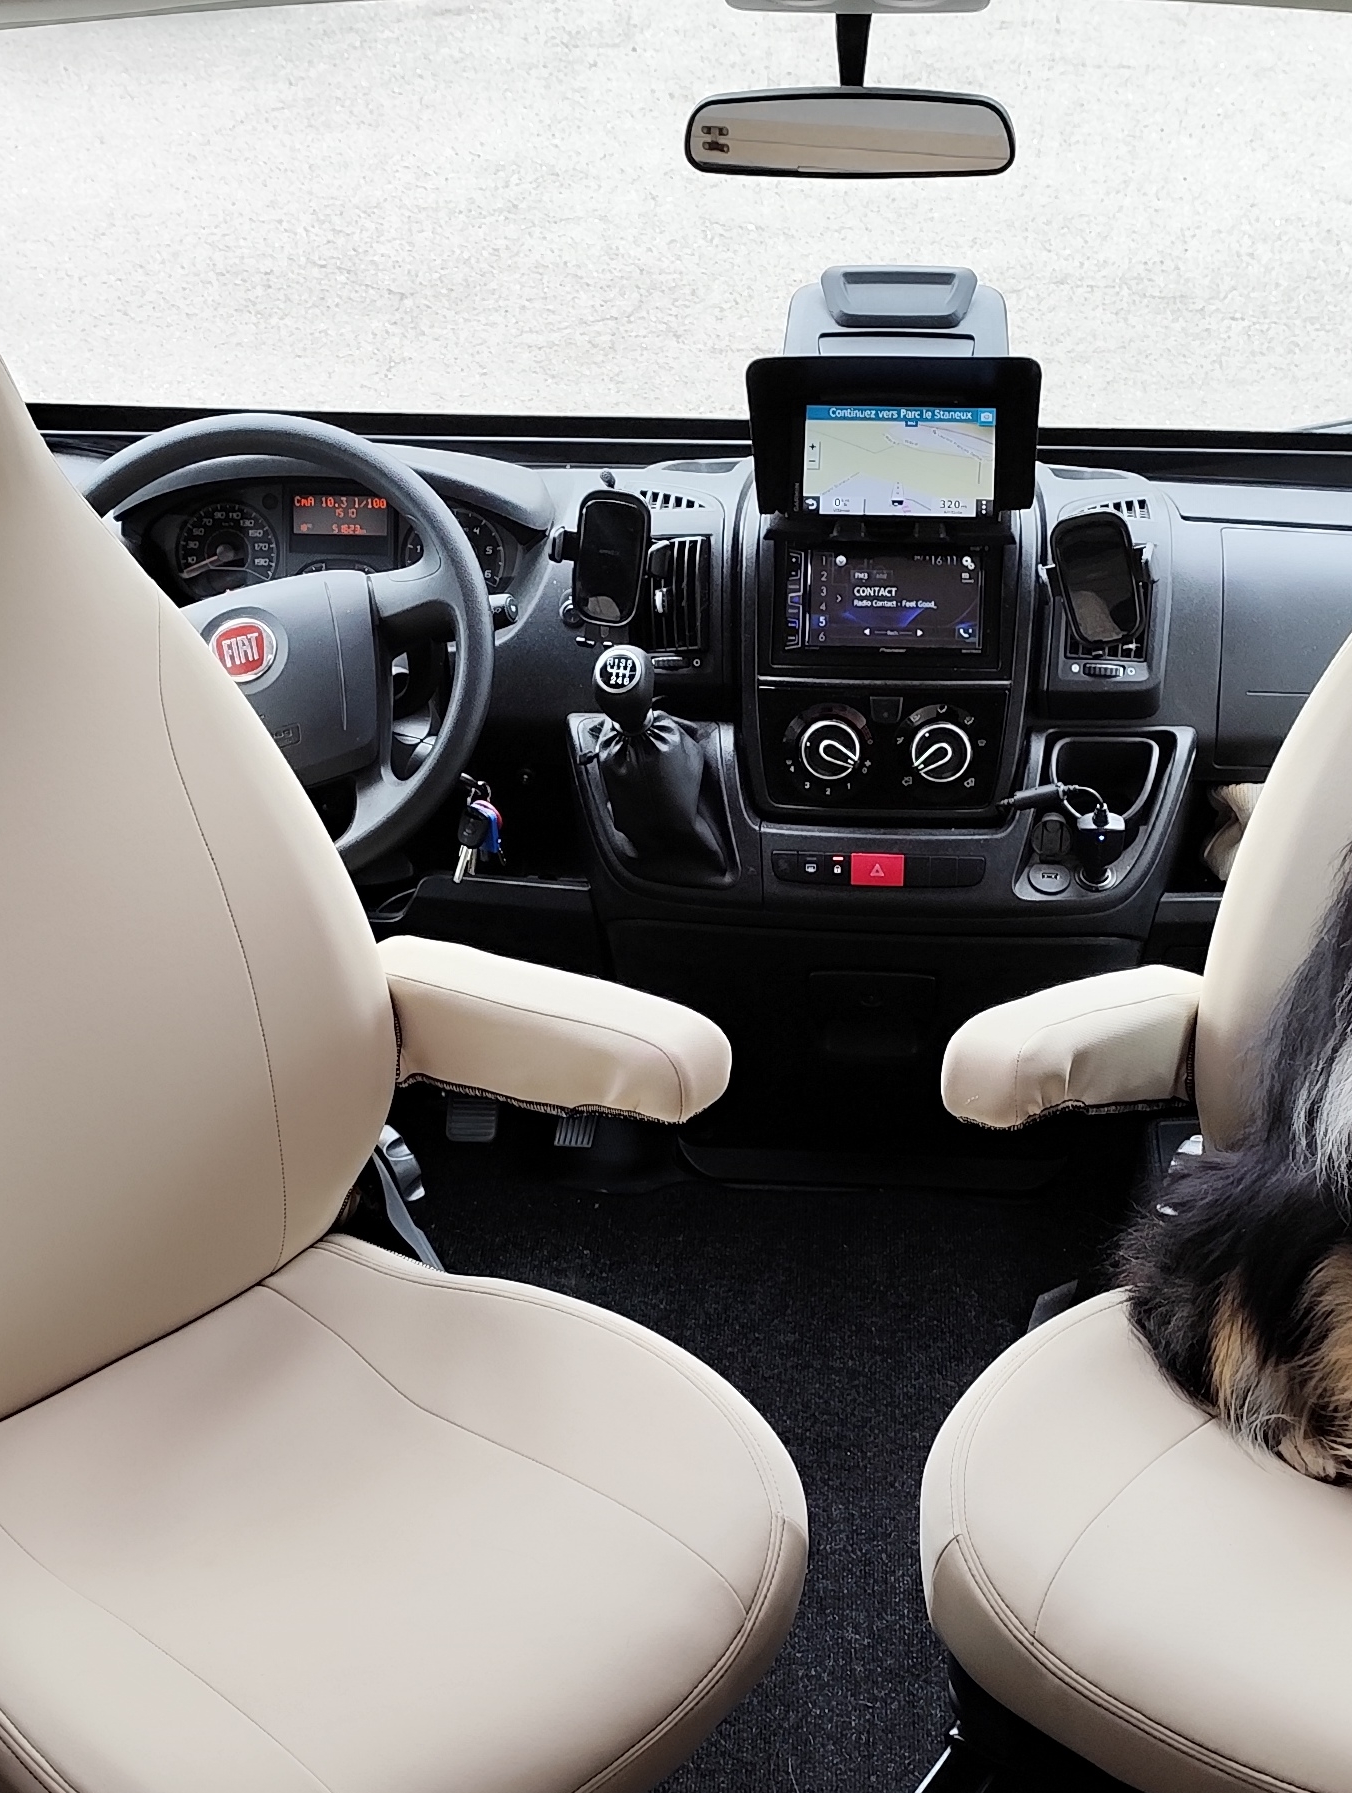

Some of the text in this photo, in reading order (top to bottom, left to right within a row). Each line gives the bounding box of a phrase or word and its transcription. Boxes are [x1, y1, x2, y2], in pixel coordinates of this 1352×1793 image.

[829, 407, 972, 420] Continuez vers Parc le Staneux
[321, 496, 347, 508] 10.3
[940, 499, 961, 509] 320
[202, 518, 213, 526] 70
[473, 527, 480, 535] 4
[485, 546, 493, 554] 5
[484, 570, 491, 578] 6
[820, 571, 827, 581] 2
[820, 586, 827, 596] 3
[853, 586, 897, 597] CONTACT
[819, 602, 826, 611] 4
[853, 599, 871, 607] Radio
[818, 616, 826, 627] 5
[818, 631, 825, 642] 6
[222, 632, 259, 667] FIAT
